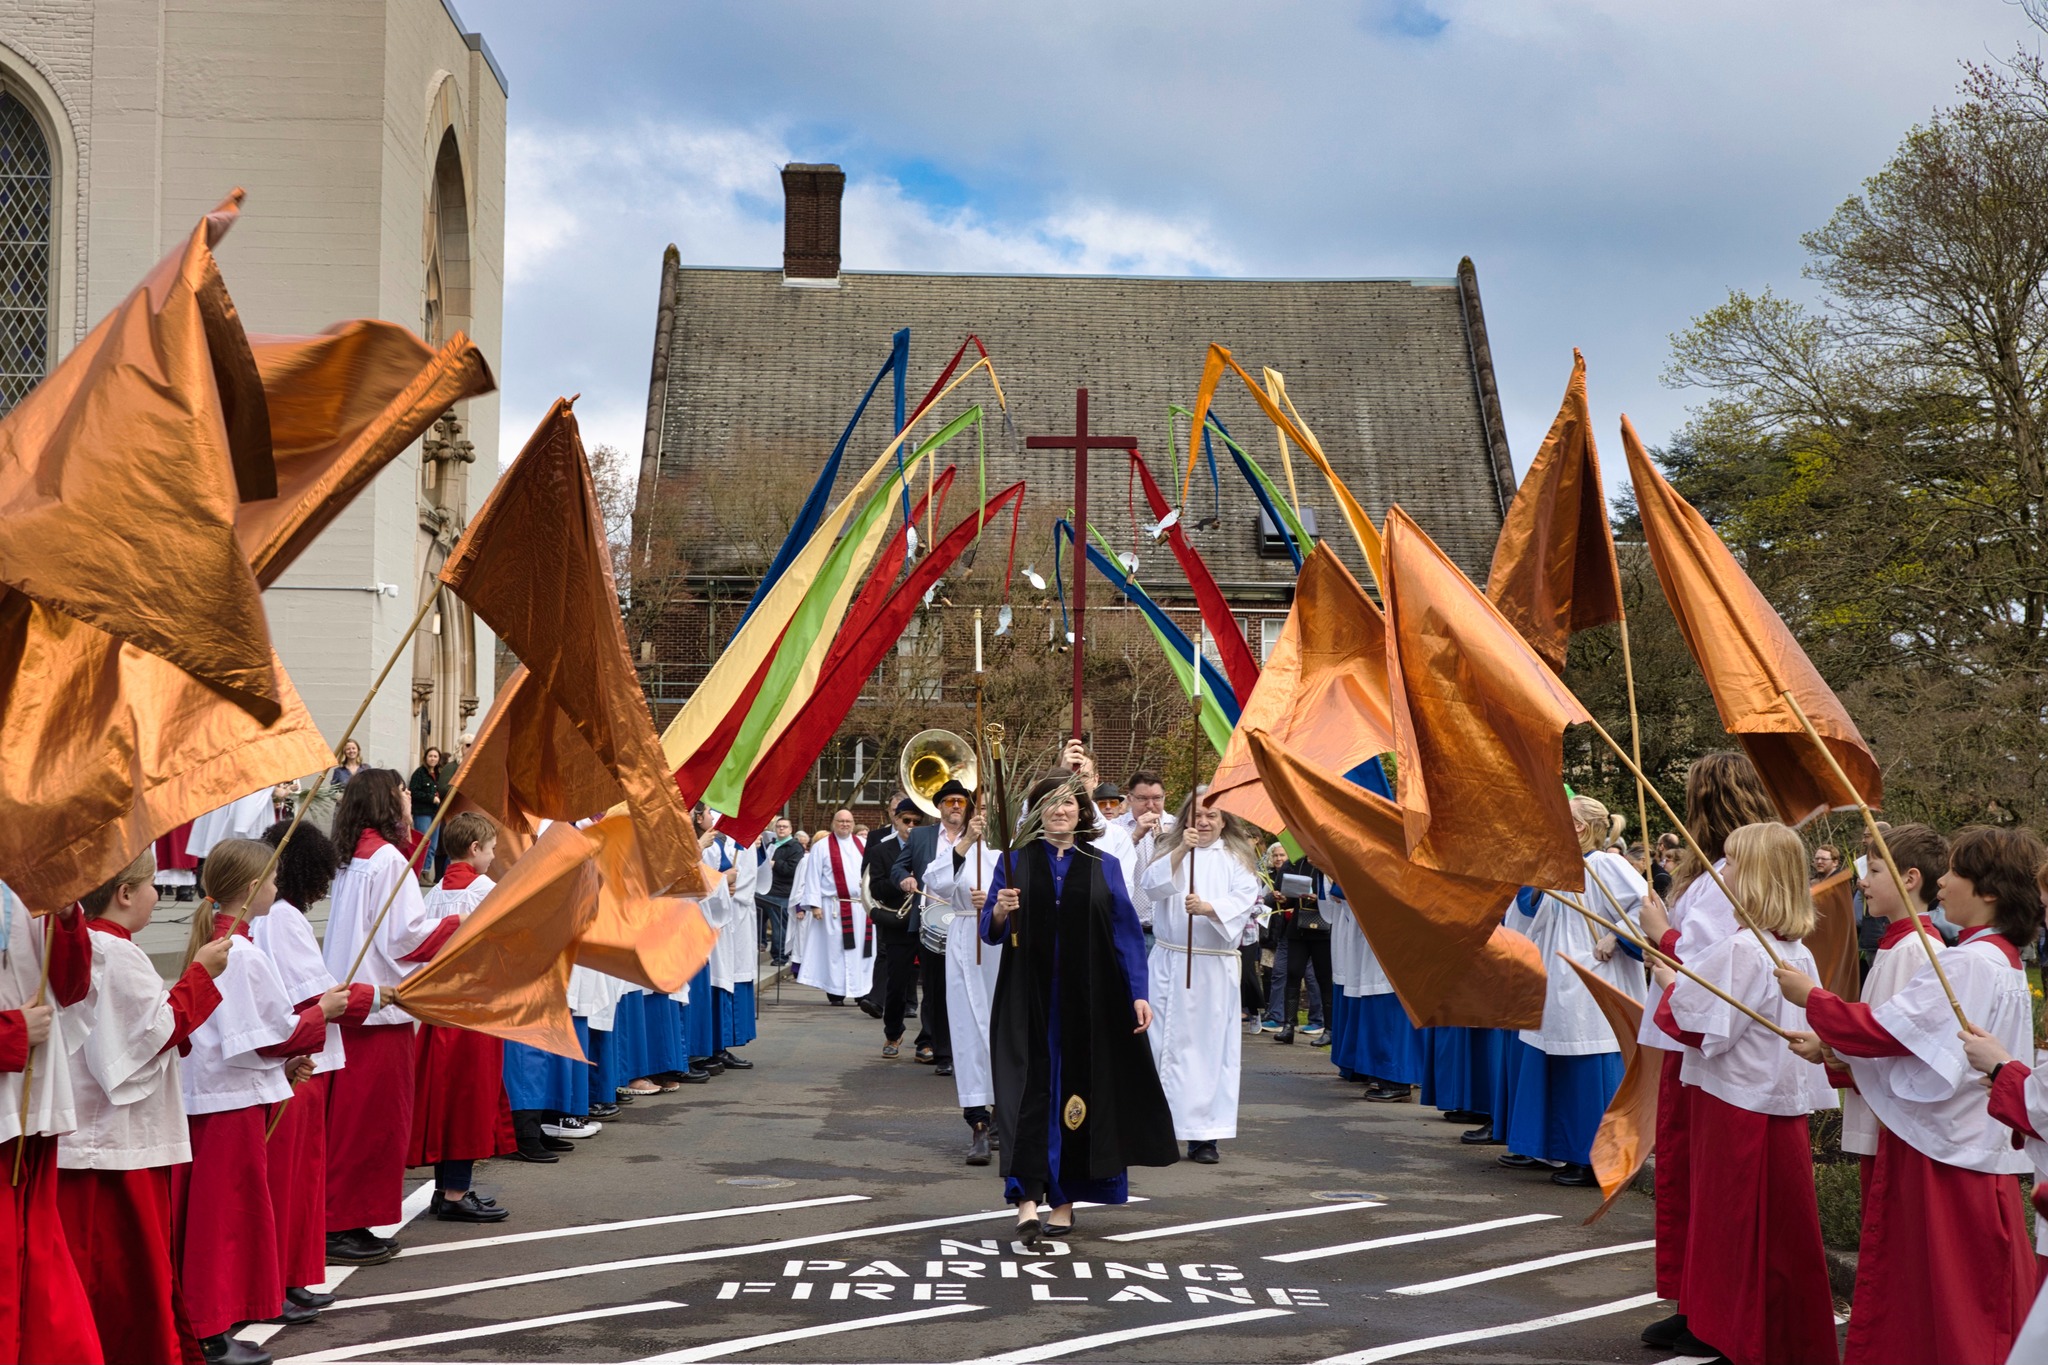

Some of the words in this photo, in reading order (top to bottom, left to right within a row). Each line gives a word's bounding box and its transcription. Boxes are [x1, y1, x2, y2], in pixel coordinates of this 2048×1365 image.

[940, 1239, 1071, 1256] NO
[782, 1260, 1245, 1282] PARKING
[716, 1282, 967, 1301] FIRE
[1030, 1284, 1330, 1307] LANE
